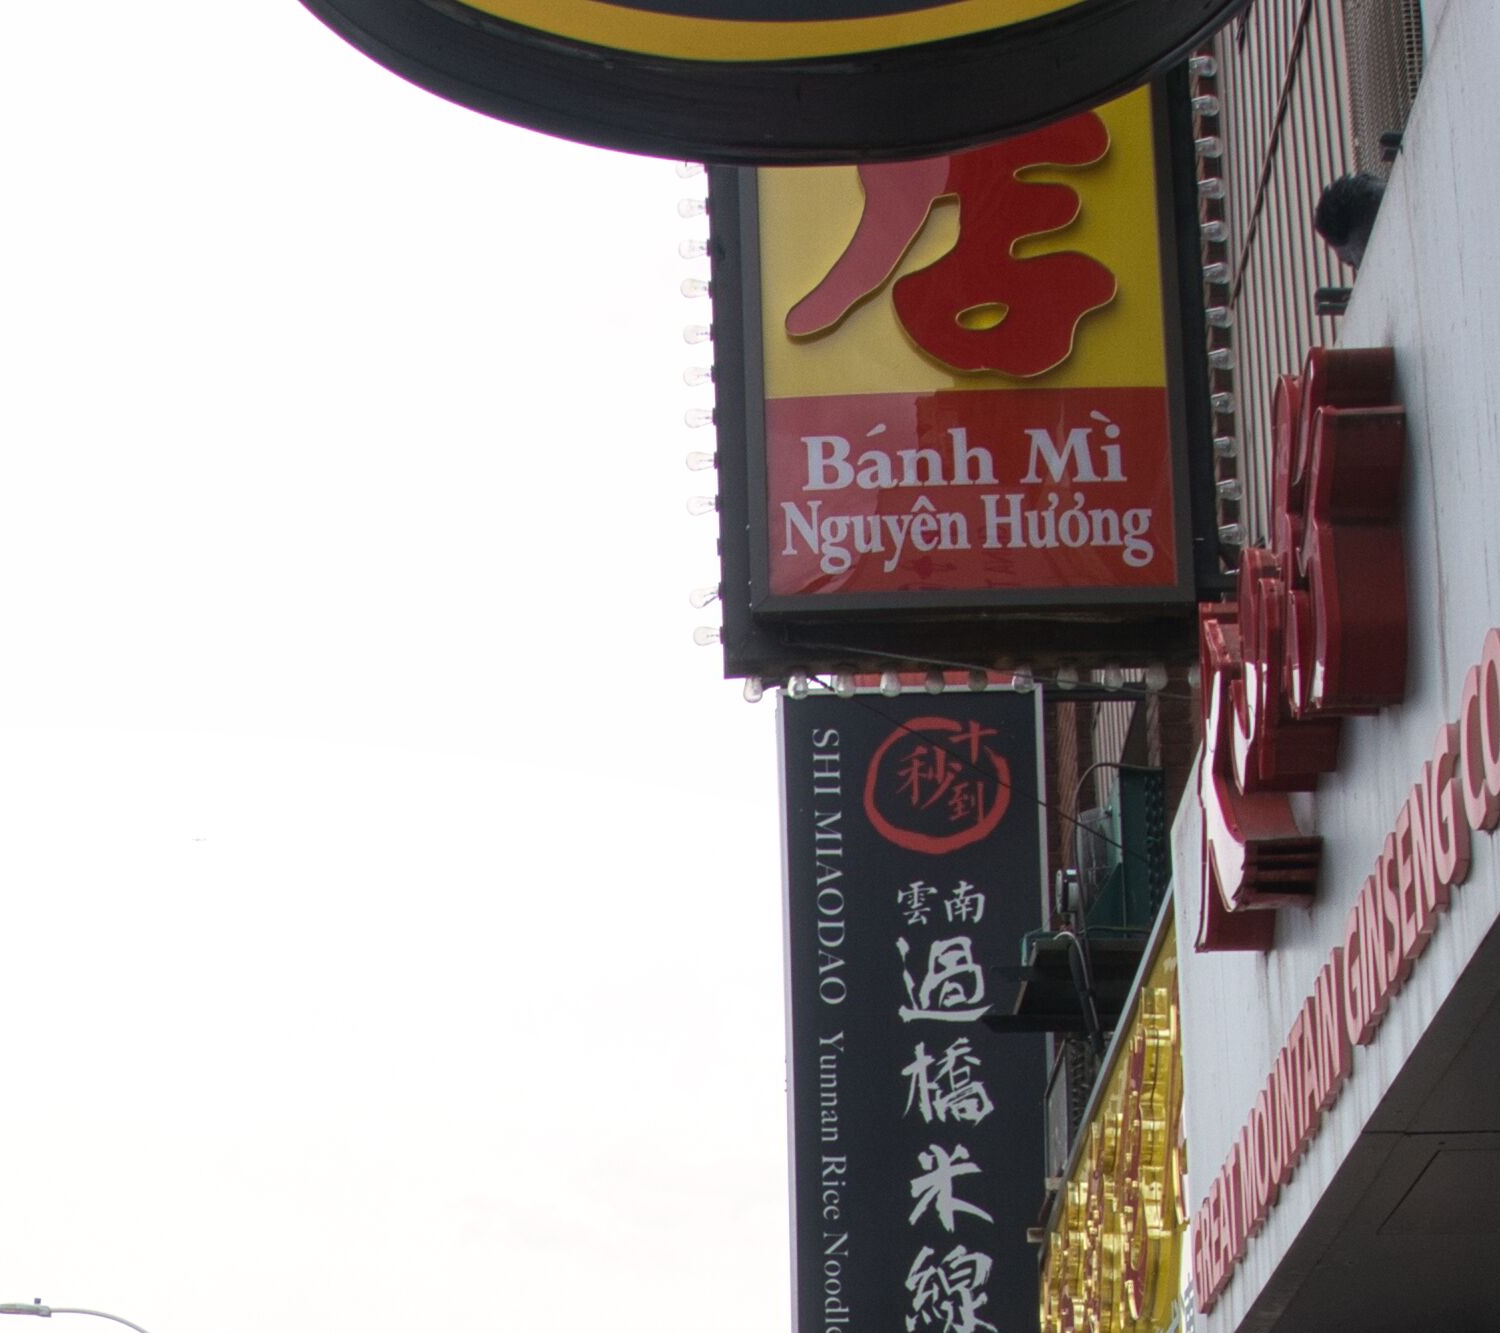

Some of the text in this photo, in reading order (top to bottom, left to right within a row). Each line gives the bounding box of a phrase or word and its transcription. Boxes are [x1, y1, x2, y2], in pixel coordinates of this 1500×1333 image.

[801, 410, 1127, 491] Bánh Mì
[781, 495, 970, 575] Nguyên
[812, 728, 841, 795] SHI
[814, 810, 847, 1005] MIAODAO
[897, 880, 985, 925] 雲南
[1193, 1140, 1246, 1314] GREAT
[1240, 946, 1350, 1237] MOUNTAIN
[1344, 722, 1469, 1045] GINSENG
[819, 1031, 844, 1142] Yunnan
[821, 1155, 847, 1220] Rice
